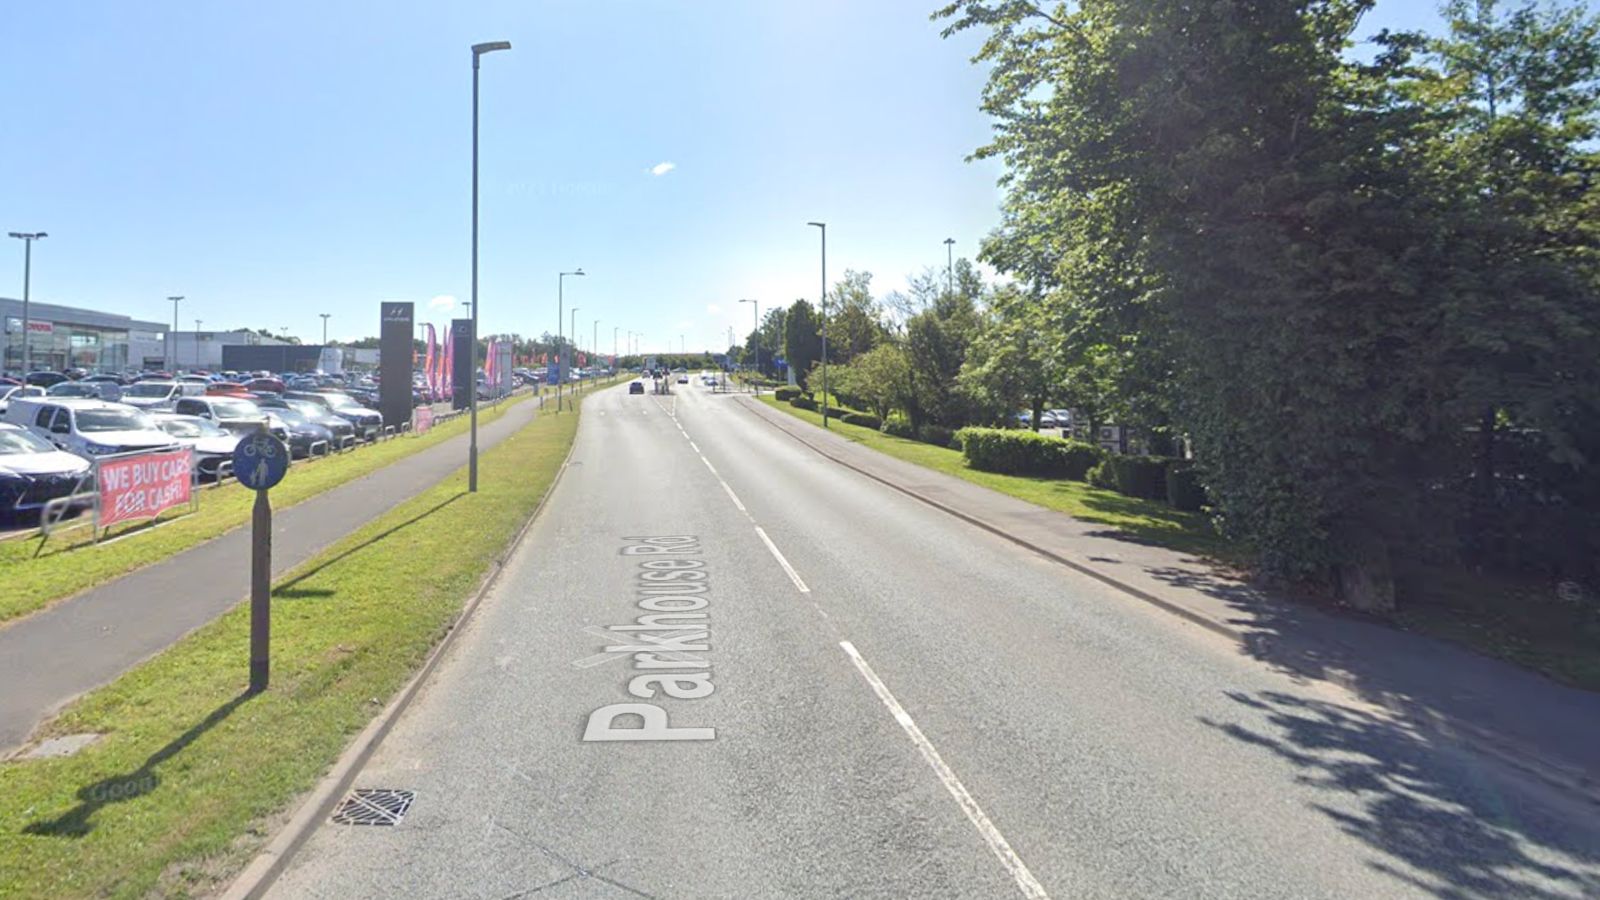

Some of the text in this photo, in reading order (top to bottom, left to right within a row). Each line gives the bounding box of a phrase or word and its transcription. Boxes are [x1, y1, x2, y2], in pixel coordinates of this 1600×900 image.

[103, 456, 190, 491] WE BUY CARS
[115, 490, 145, 514] FOR
